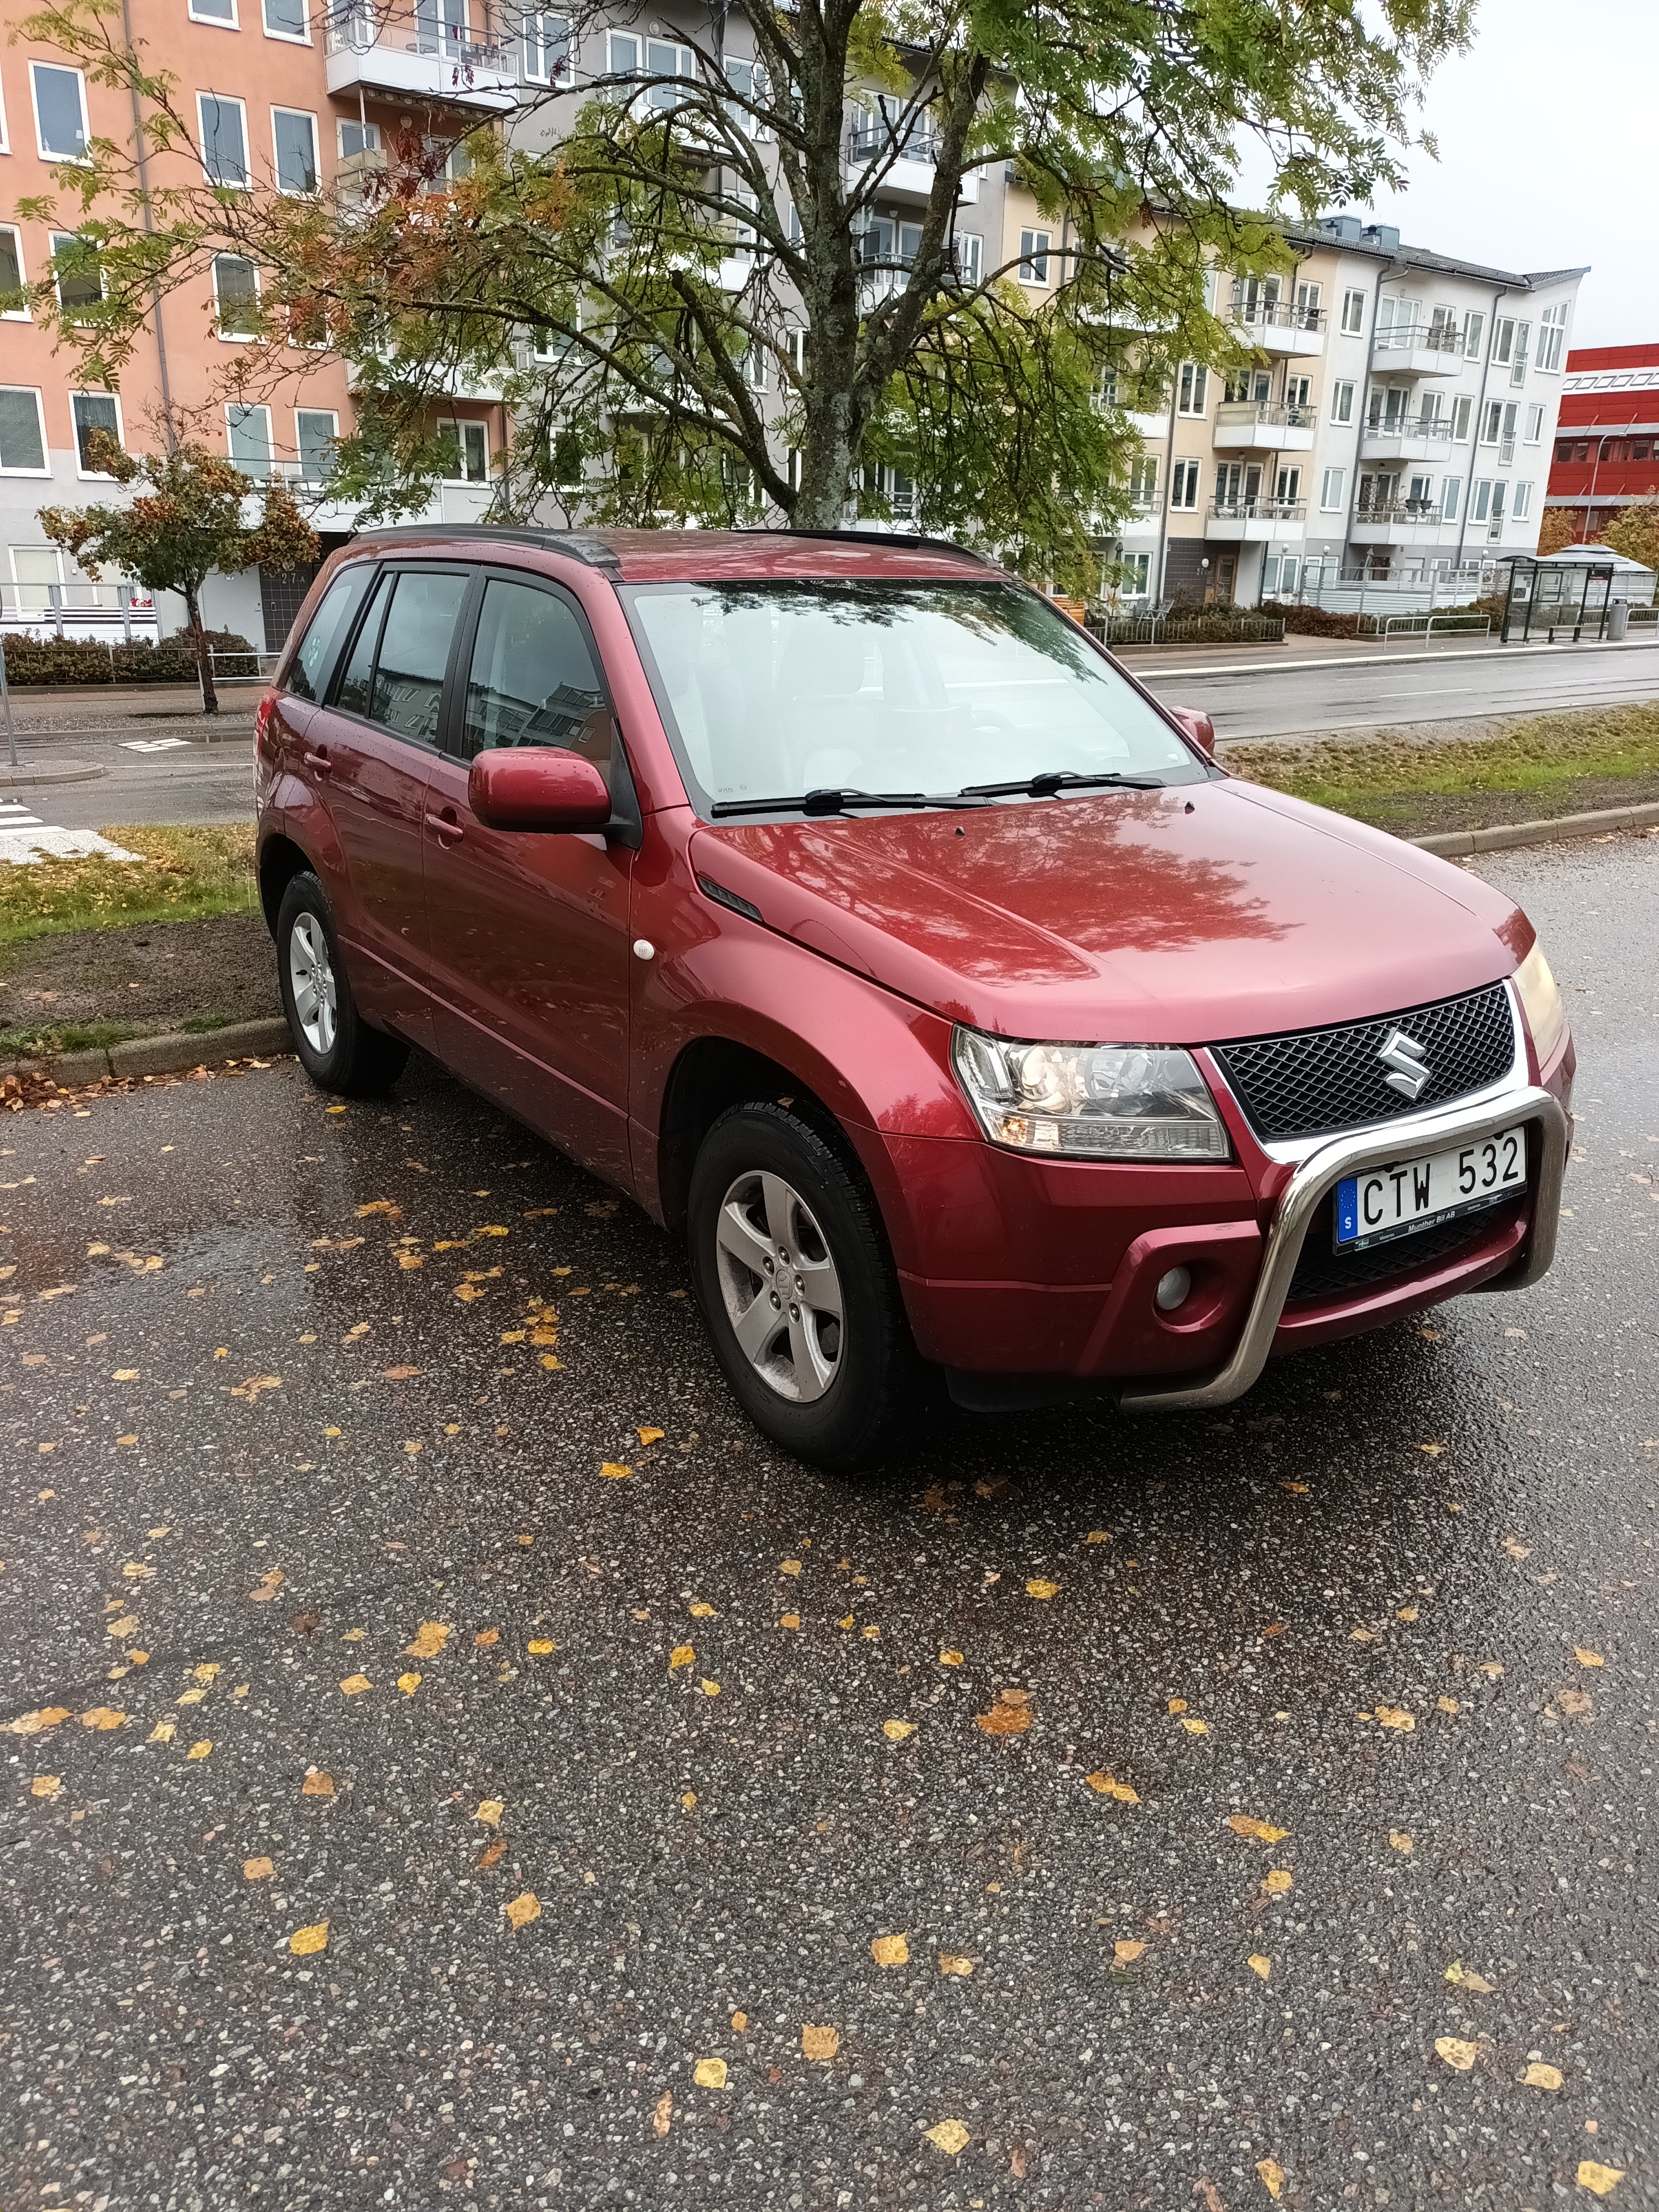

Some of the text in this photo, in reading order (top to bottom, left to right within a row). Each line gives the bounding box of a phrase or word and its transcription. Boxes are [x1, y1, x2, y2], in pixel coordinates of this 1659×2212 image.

[1364, 1136, 1519, 1225] CTW 532
[1344, 1217, 1352, 1229] S
[1407, 1211, 1455, 1233] Munther Bil AB
